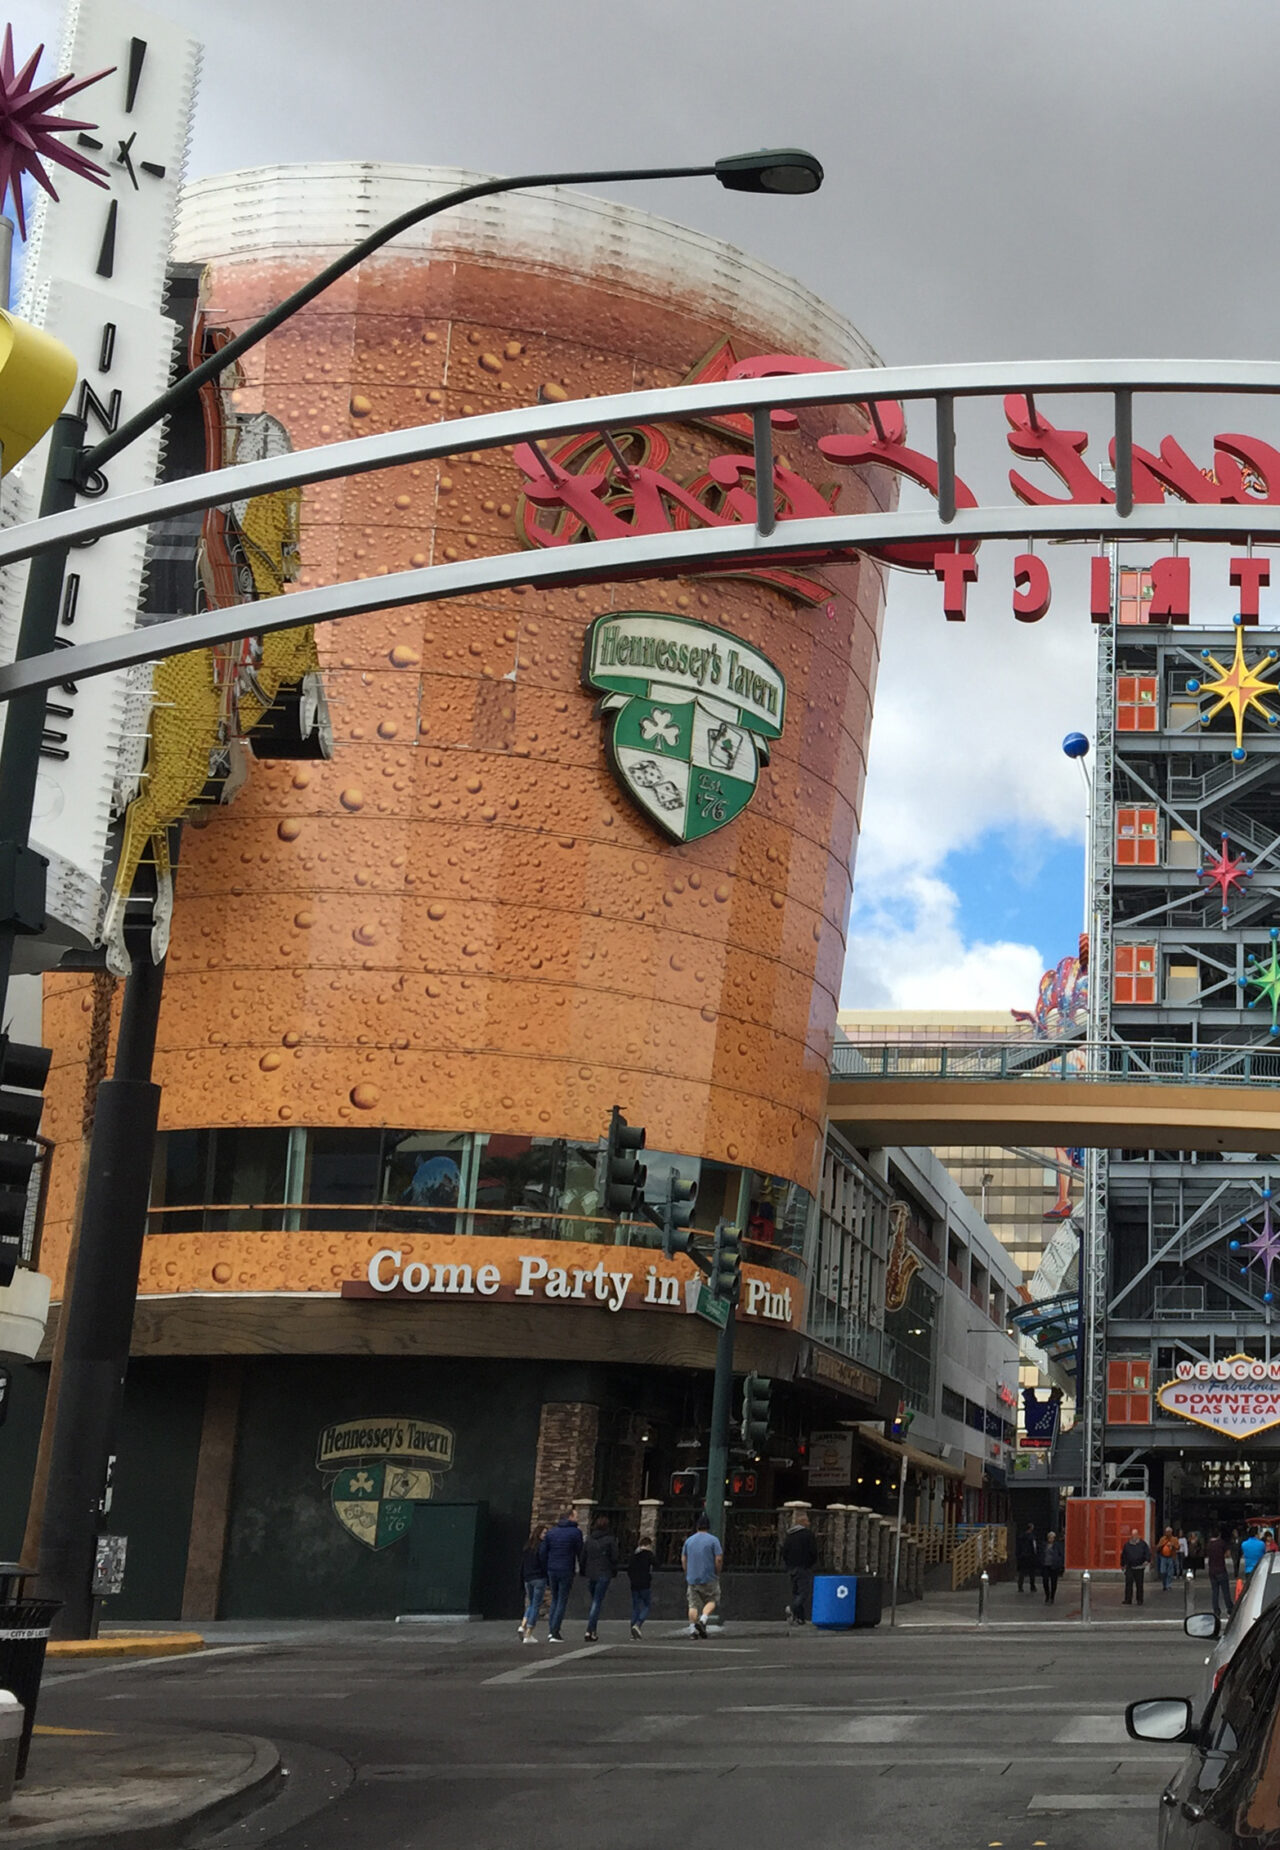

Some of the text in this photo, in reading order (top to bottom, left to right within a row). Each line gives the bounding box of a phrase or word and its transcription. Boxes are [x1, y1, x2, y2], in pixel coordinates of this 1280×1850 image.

[600, 625, 779, 717] Hennessey's Tavern
[367, 1250, 501, 1294] Come
[515, 1256, 633, 1312] Party
[644, 1265, 681, 1306] in
[746, 1278, 793, 1323] Pint
[1192, 1379, 1278, 1393] TO Fabulous
[1190, 1404, 1222, 1414] LAS
[323, 1422, 449, 1455] Hennessey's Tavern
[10, 1630, 26, 1638] CITY
